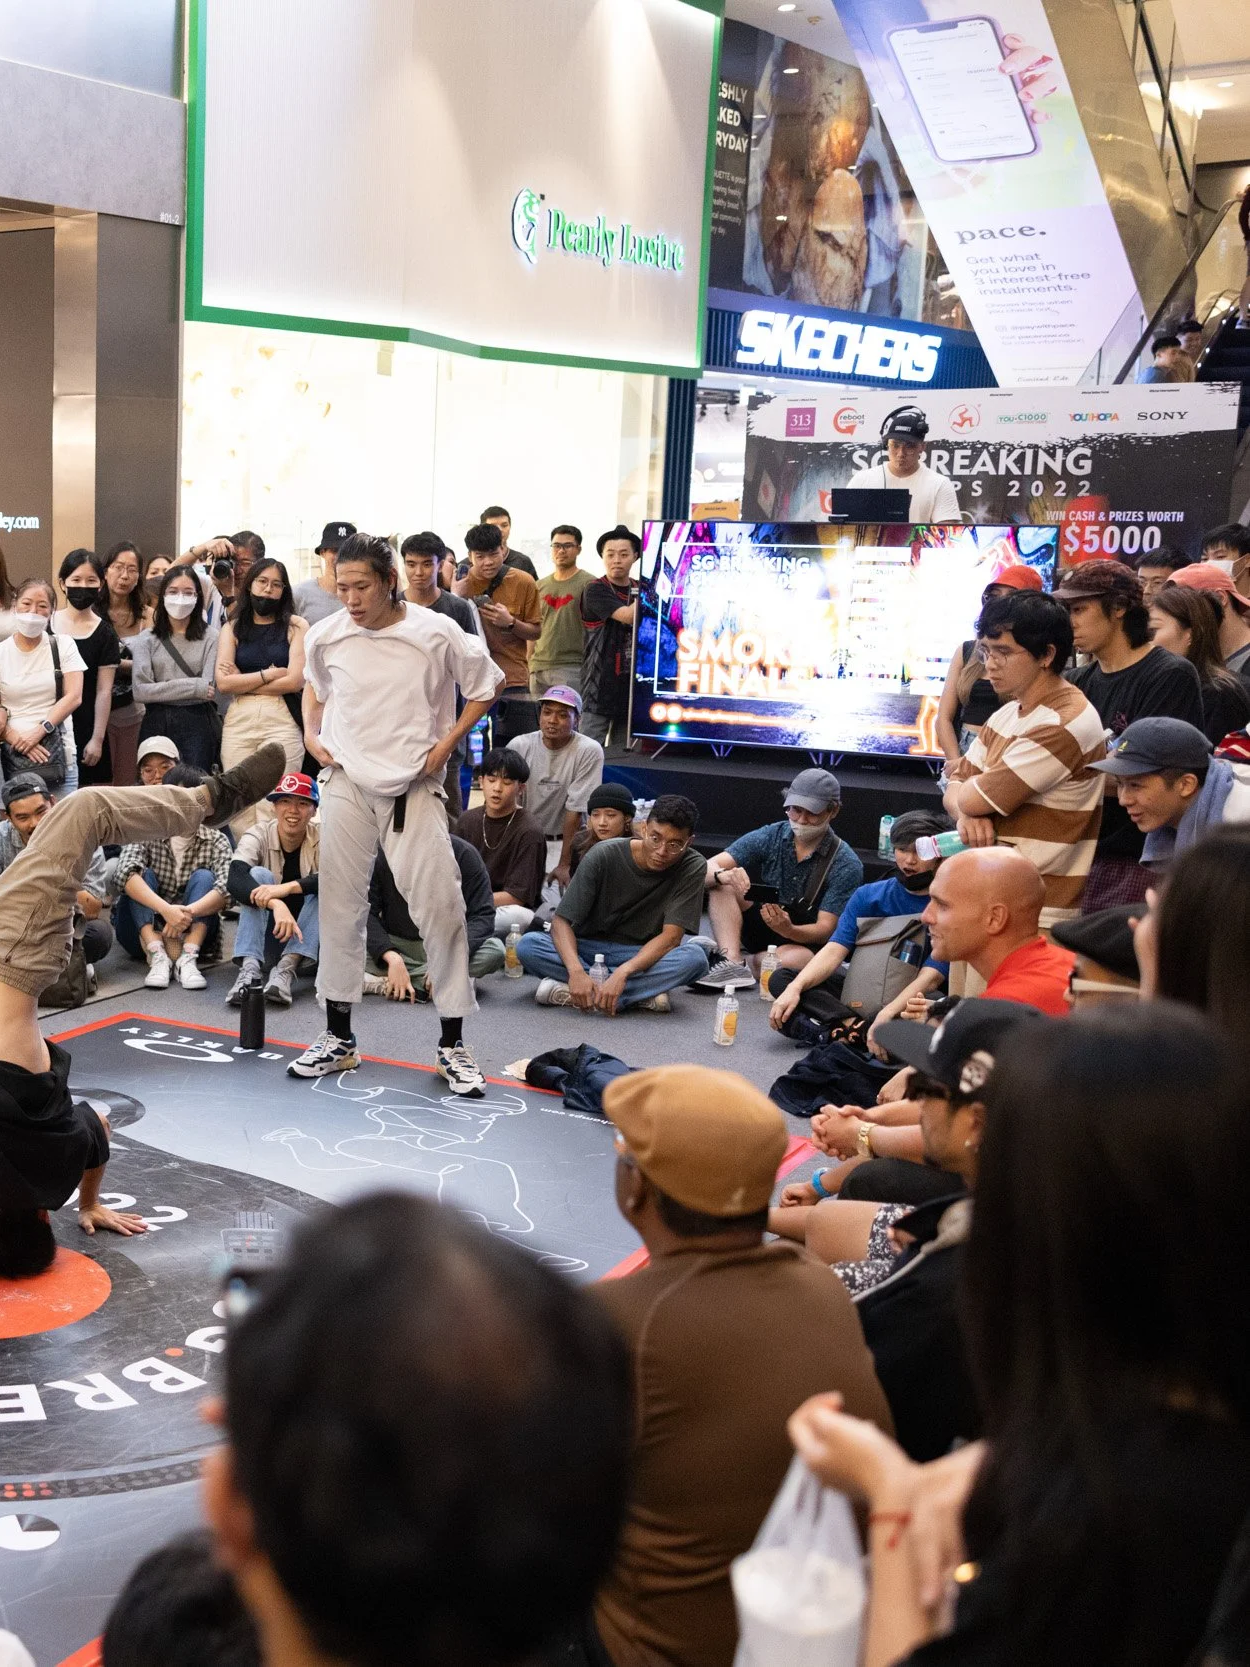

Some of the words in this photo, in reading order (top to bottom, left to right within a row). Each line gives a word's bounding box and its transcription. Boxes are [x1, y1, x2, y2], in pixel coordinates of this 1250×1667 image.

[718, 81, 748, 104] SHLY
[717, 107, 741, 127] KED
[547, 208, 618, 267] Pearly
[619, 223, 686, 271] Lustre
[954, 225, 1047, 245] pace.
[966, 256, 996, 265] Get
[1000, 252, 1042, 263] what
[970, 267, 999, 277] you
[1004, 264, 1037, 274] love
[1042, 263, 1057, 271] in
[975, 278, 986, 286] 3
[990, 271, 1091, 285] interest-free
[736, 309, 943, 383] SKECHERS
[790, 413, 811, 427] 313
[839, 413, 865, 421] reboot
[1069, 412, 1120, 422] YOUTHOPIA
[1137, 411, 1189, 421] SONY
[1007, 480, 1091, 497] 2022
[1046, 511, 1066, 522] WIN
[1068, 511, 1095, 522] CASH
[1098, 511, 1106, 522] &
[1108, 511, 1144, 522] PRIZES
[1147, 511, 1184, 522] WORTH
[1064, 522, 1161, 555] $5000
[677, 629, 794, 664] SMOK
[677, 662, 806, 696] FINAL
[118, 1027, 284, 1060] OAKLEY
